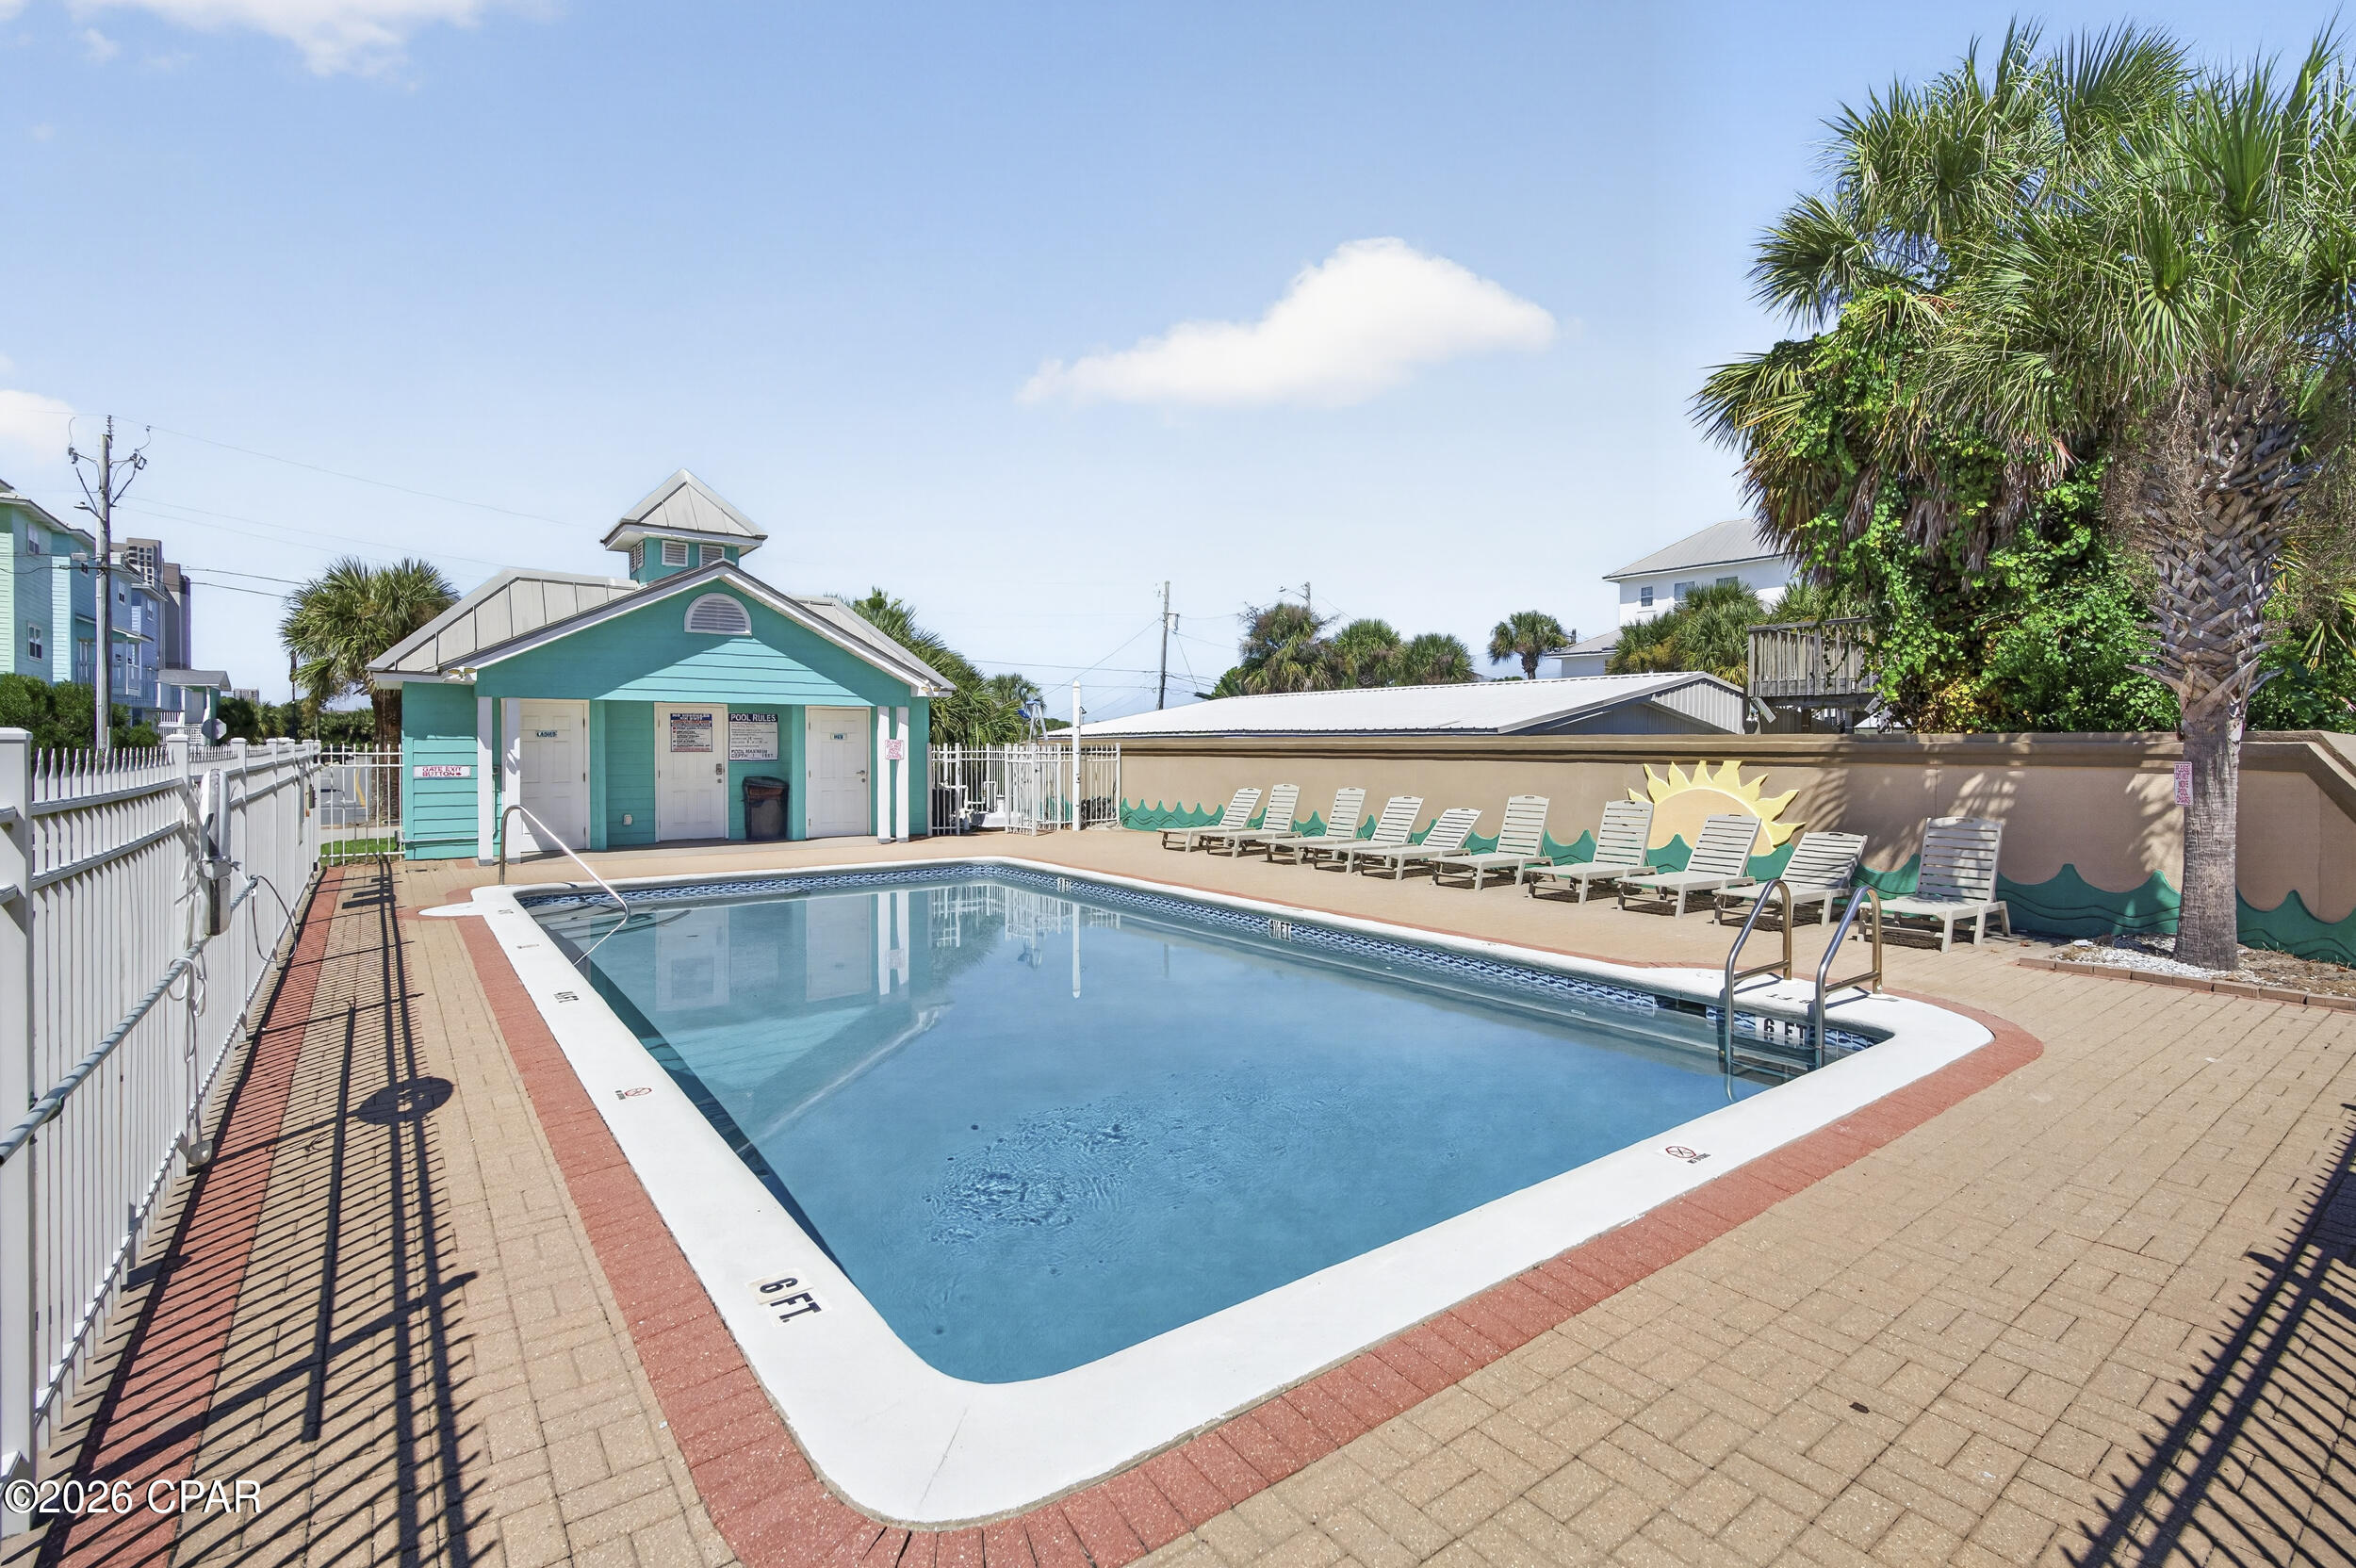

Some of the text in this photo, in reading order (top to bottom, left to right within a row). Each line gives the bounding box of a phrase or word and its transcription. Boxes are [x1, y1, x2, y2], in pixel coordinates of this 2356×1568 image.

[730, 713, 777, 722] POOL RULES
[1763, 1018, 1808, 1039] 6 FT
[760, 1277, 798, 1293] 6
